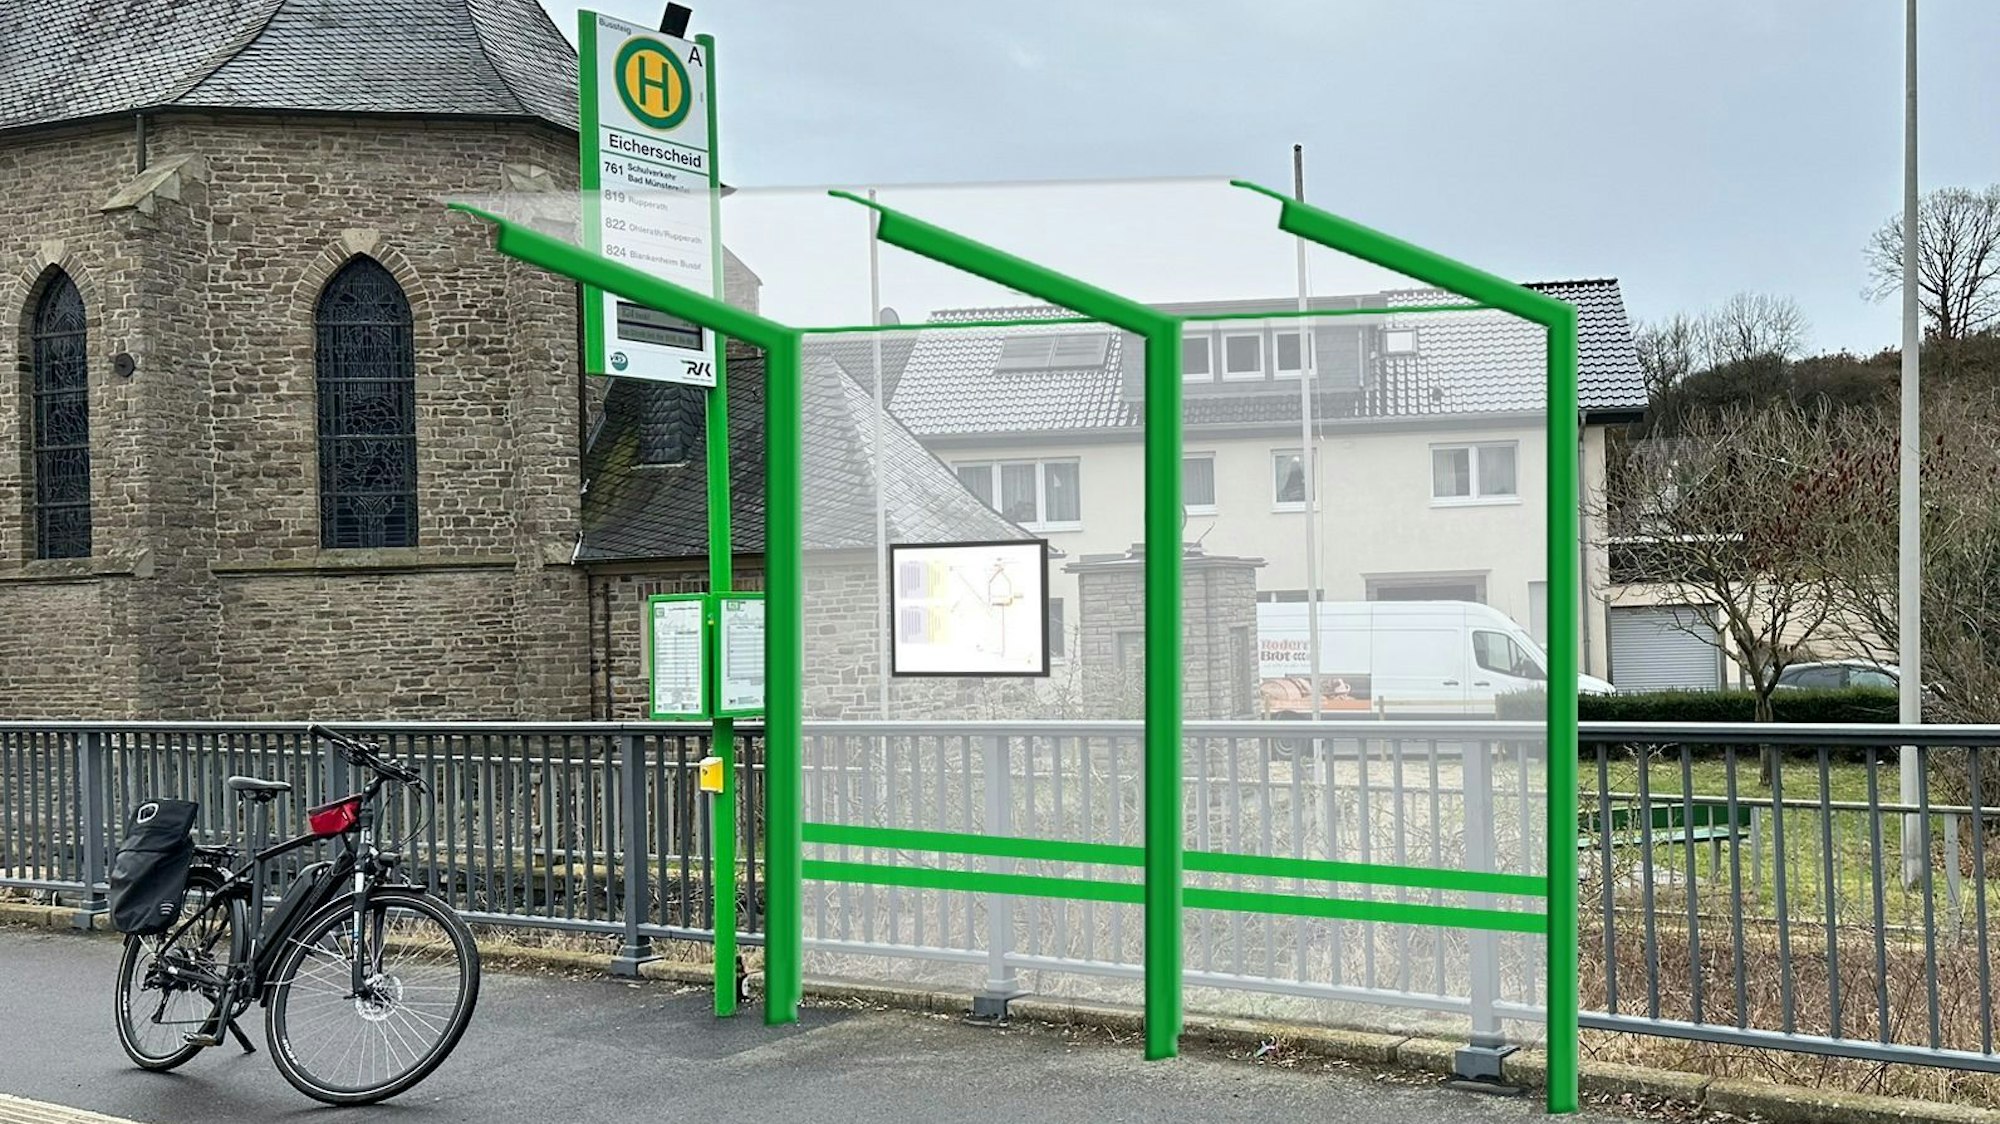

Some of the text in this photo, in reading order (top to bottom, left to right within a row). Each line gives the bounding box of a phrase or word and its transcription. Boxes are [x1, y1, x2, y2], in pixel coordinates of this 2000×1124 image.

[599, 17, 632, 35] Bussteig
[688, 46, 703, 67] A
[638, 55, 670, 112] H
[609, 133, 702, 168] Eicherscheid
[604, 161, 623, 175] 761
[627, 162, 677, 181] Schulverkehr
[627, 173, 643, 184] Bad
[604, 189, 669, 212] 819 Rupperath
[605, 217, 626, 231] 822
[606, 244, 626, 257] 824
[630, 250, 679, 266] Blankenheim
